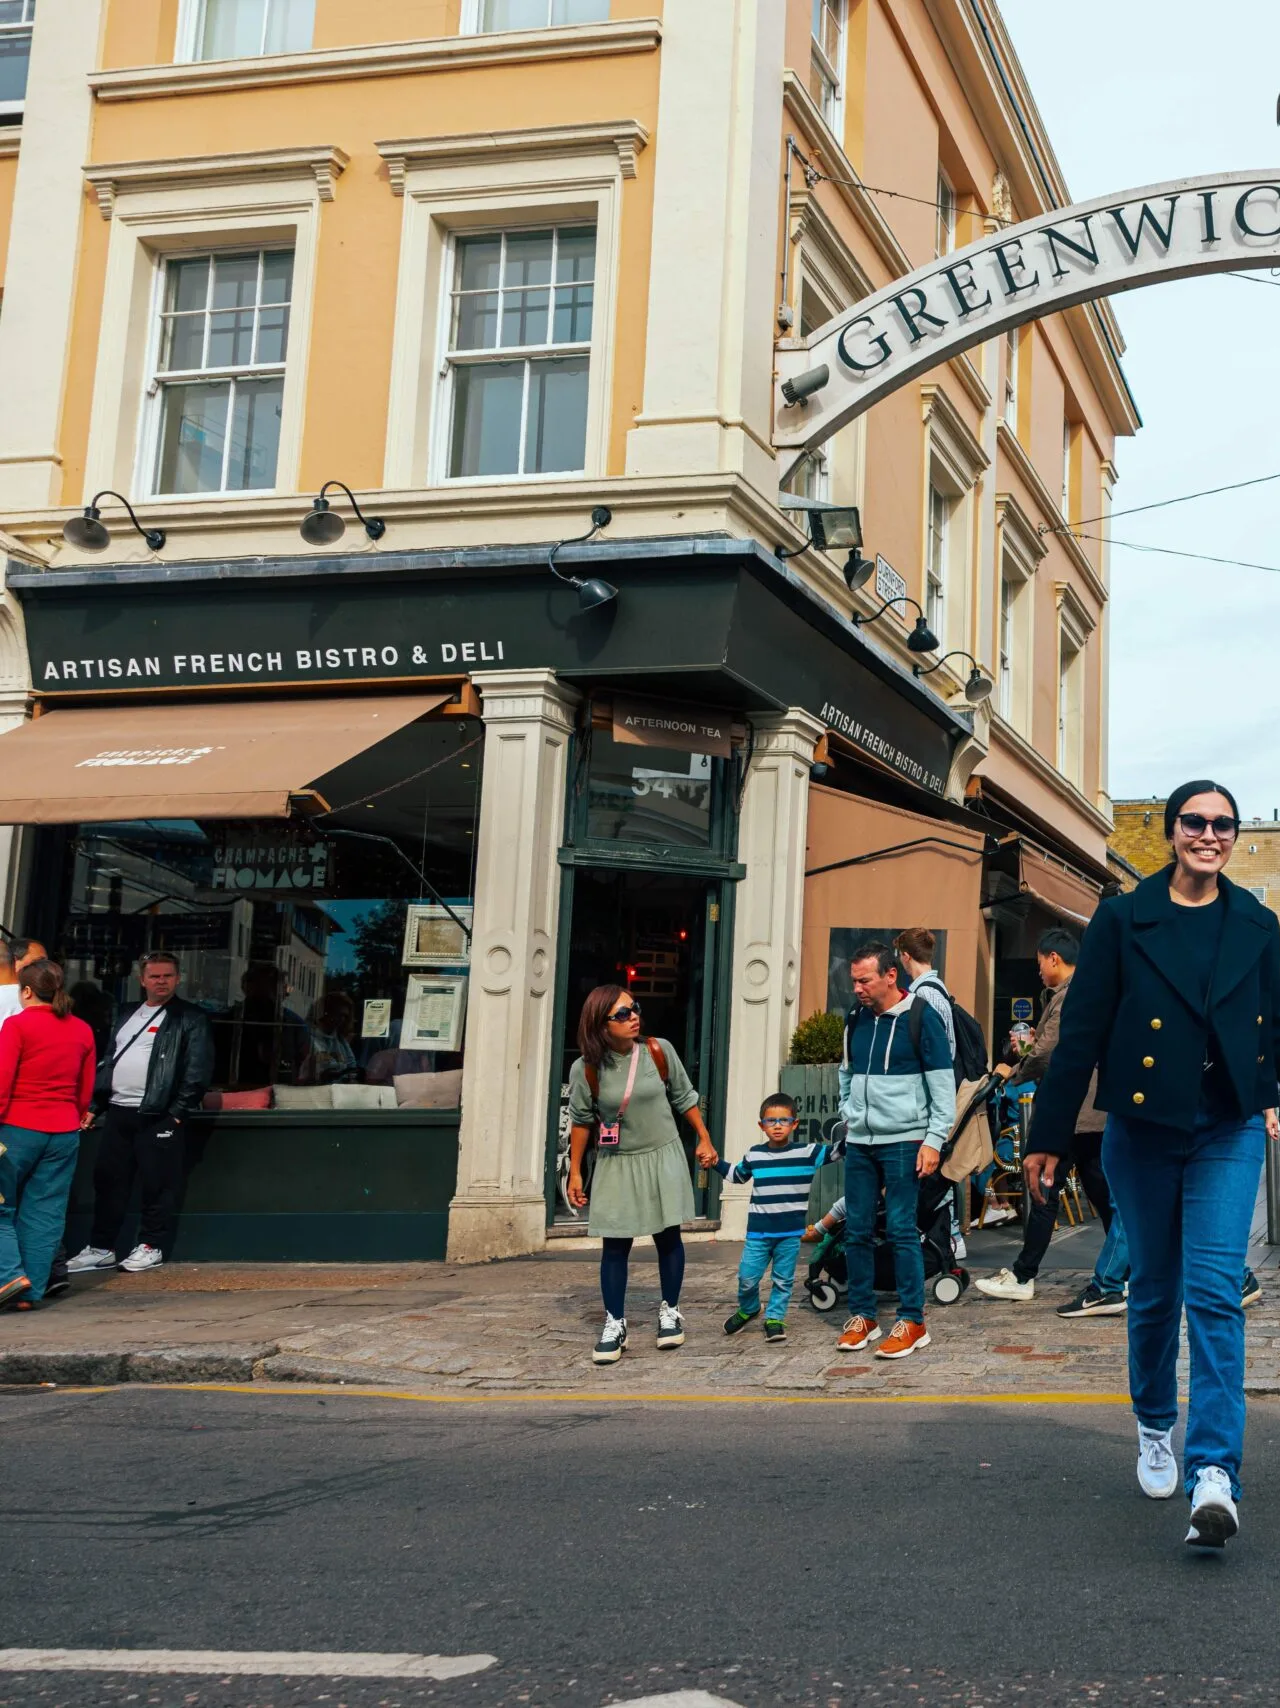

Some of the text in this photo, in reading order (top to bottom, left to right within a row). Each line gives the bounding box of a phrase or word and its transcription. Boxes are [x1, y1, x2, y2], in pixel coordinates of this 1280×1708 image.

[44, 640, 504, 680] ARTISAN FRENCH BISTRO & DELI
[625, 715, 721, 738] AFTERNOON TEA
[820, 702, 862, 739] ARTISAN
[861, 730, 895, 762] FRENCH
[894, 752, 922, 780] BISTRO
[212, 866, 326, 889] FROMAGE
